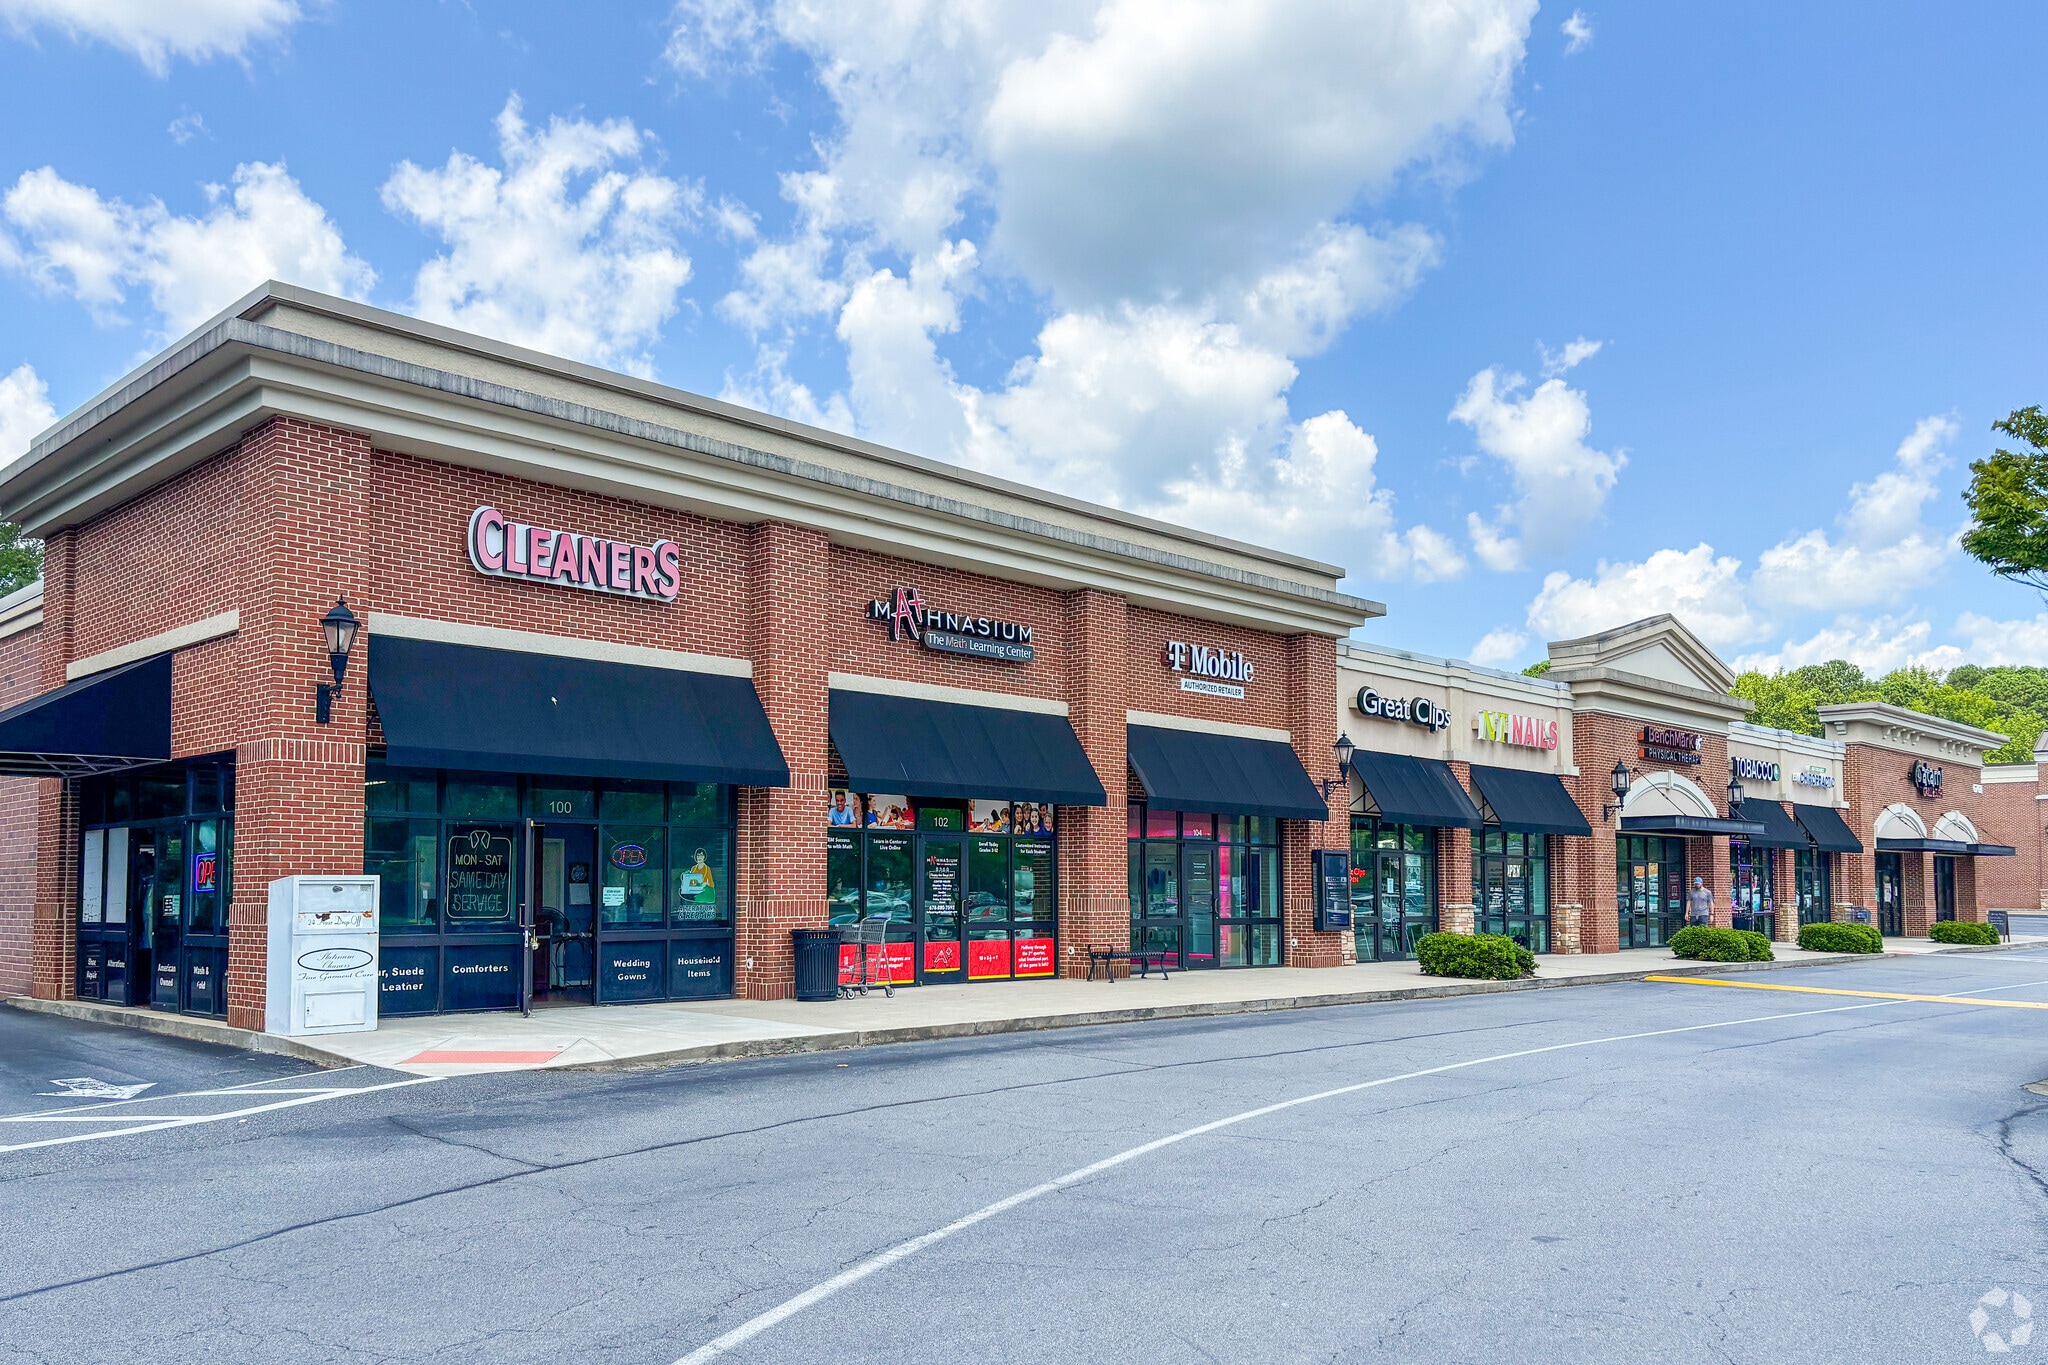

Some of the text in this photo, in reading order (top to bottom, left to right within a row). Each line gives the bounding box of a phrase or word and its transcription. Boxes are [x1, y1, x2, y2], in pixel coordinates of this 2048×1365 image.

[472, 507, 681, 600] CLEANERS
[927, 633, 1032, 659] The Math Learning Center
[1183, 680, 1242, 697] AUTHORIZED RETAILER
[1360, 687, 1452, 733] Great Clips
[1479, 710, 1558, 750] NT NAILS
[1648, 747, 1678, 761] PHYSICAL
[1733, 757, 1773, 781] TOBACCO
[549, 800, 572, 814] 100
[933, 816, 949, 828] 102
[1192, 828, 1203, 837] 104
[612, 849, 647, 864] OPEN
[450, 870, 508, 889] SAME DAY
[452, 893, 503, 912] SERVICE
[684, 911, 717, 920] REPAIRS
[613, 958, 651, 969] Wedding
[677, 955, 721, 966] Household
[157, 963, 177, 973] American
[193, 965, 206, 976] Wash
[391, 967, 425, 977] Suede
[452, 964, 509, 974] Comforters
[319, 972, 353, 982] Garment
[617, 973, 647, 981] Gowns
[687, 970, 711, 978] Items
[159, 977, 174, 987] Owned
[382, 982, 424, 992] Leather
